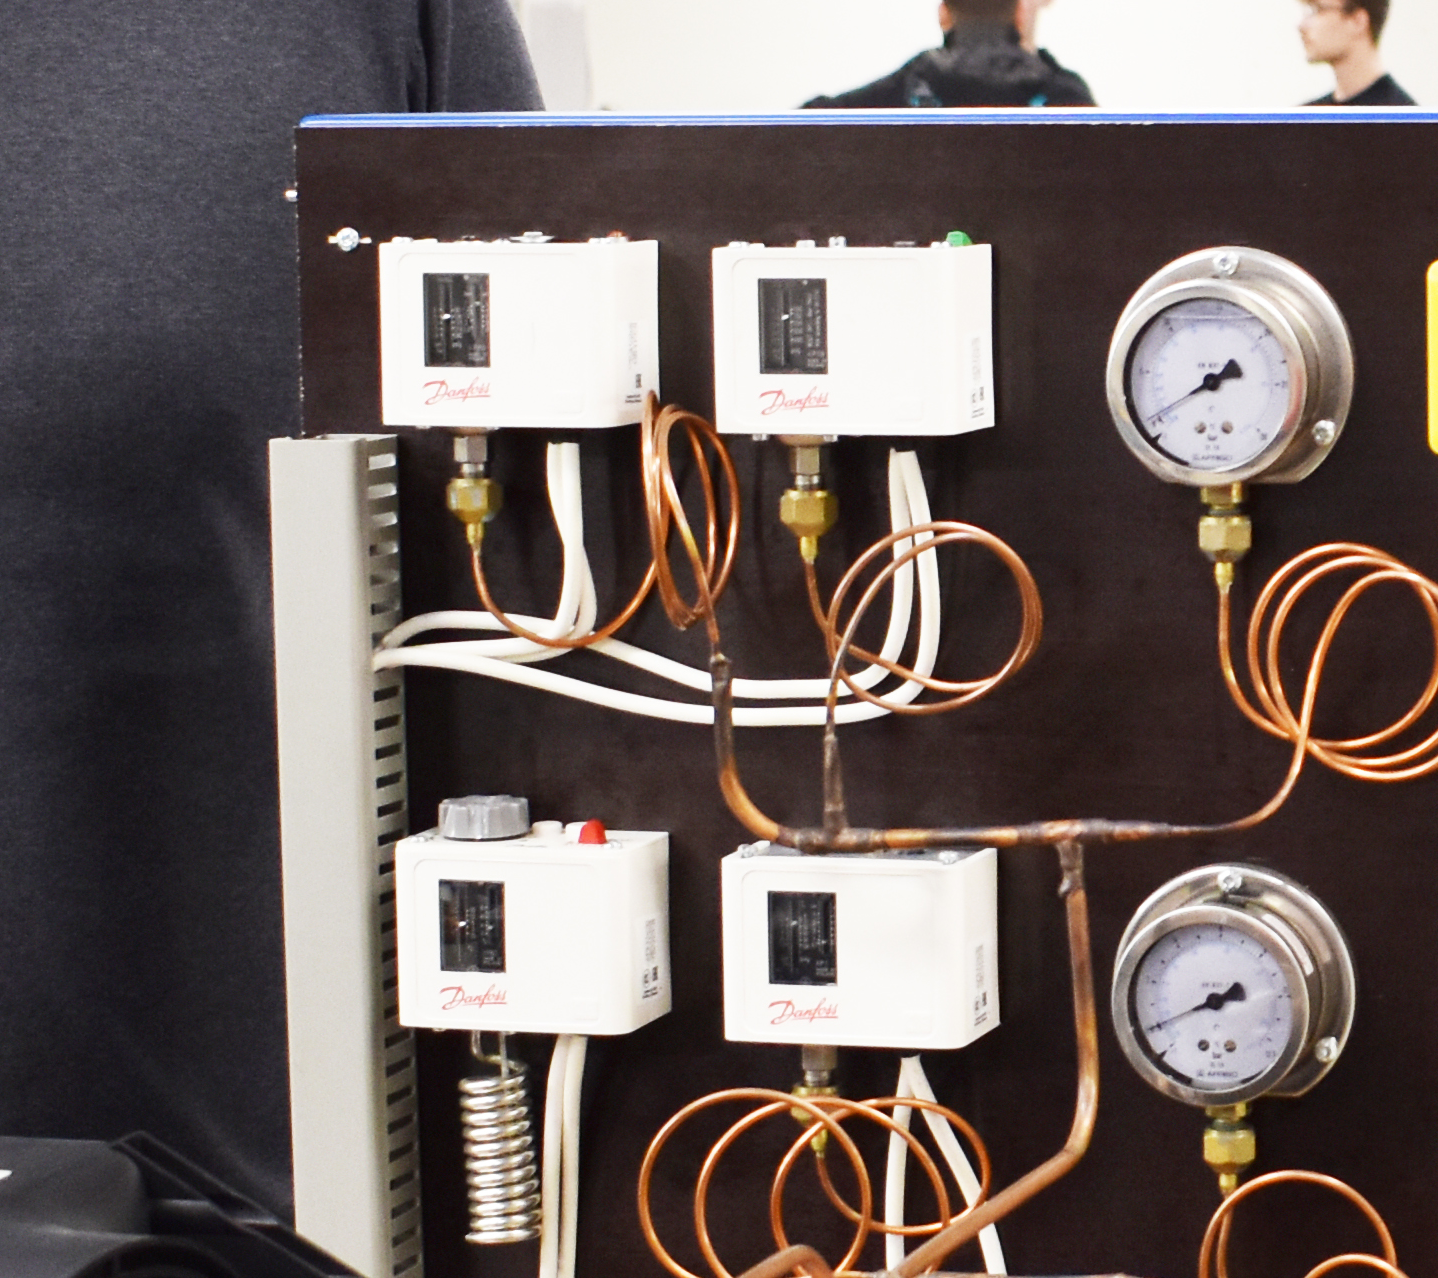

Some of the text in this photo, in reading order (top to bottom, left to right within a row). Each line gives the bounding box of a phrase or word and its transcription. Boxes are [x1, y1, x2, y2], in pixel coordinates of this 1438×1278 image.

[422, 376, 492, 406] Danfoss
[758, 385, 830, 416] Danfoss
[438, 983, 508, 1012] Danfoss
[767, 997, 839, 1026] Danfoss
